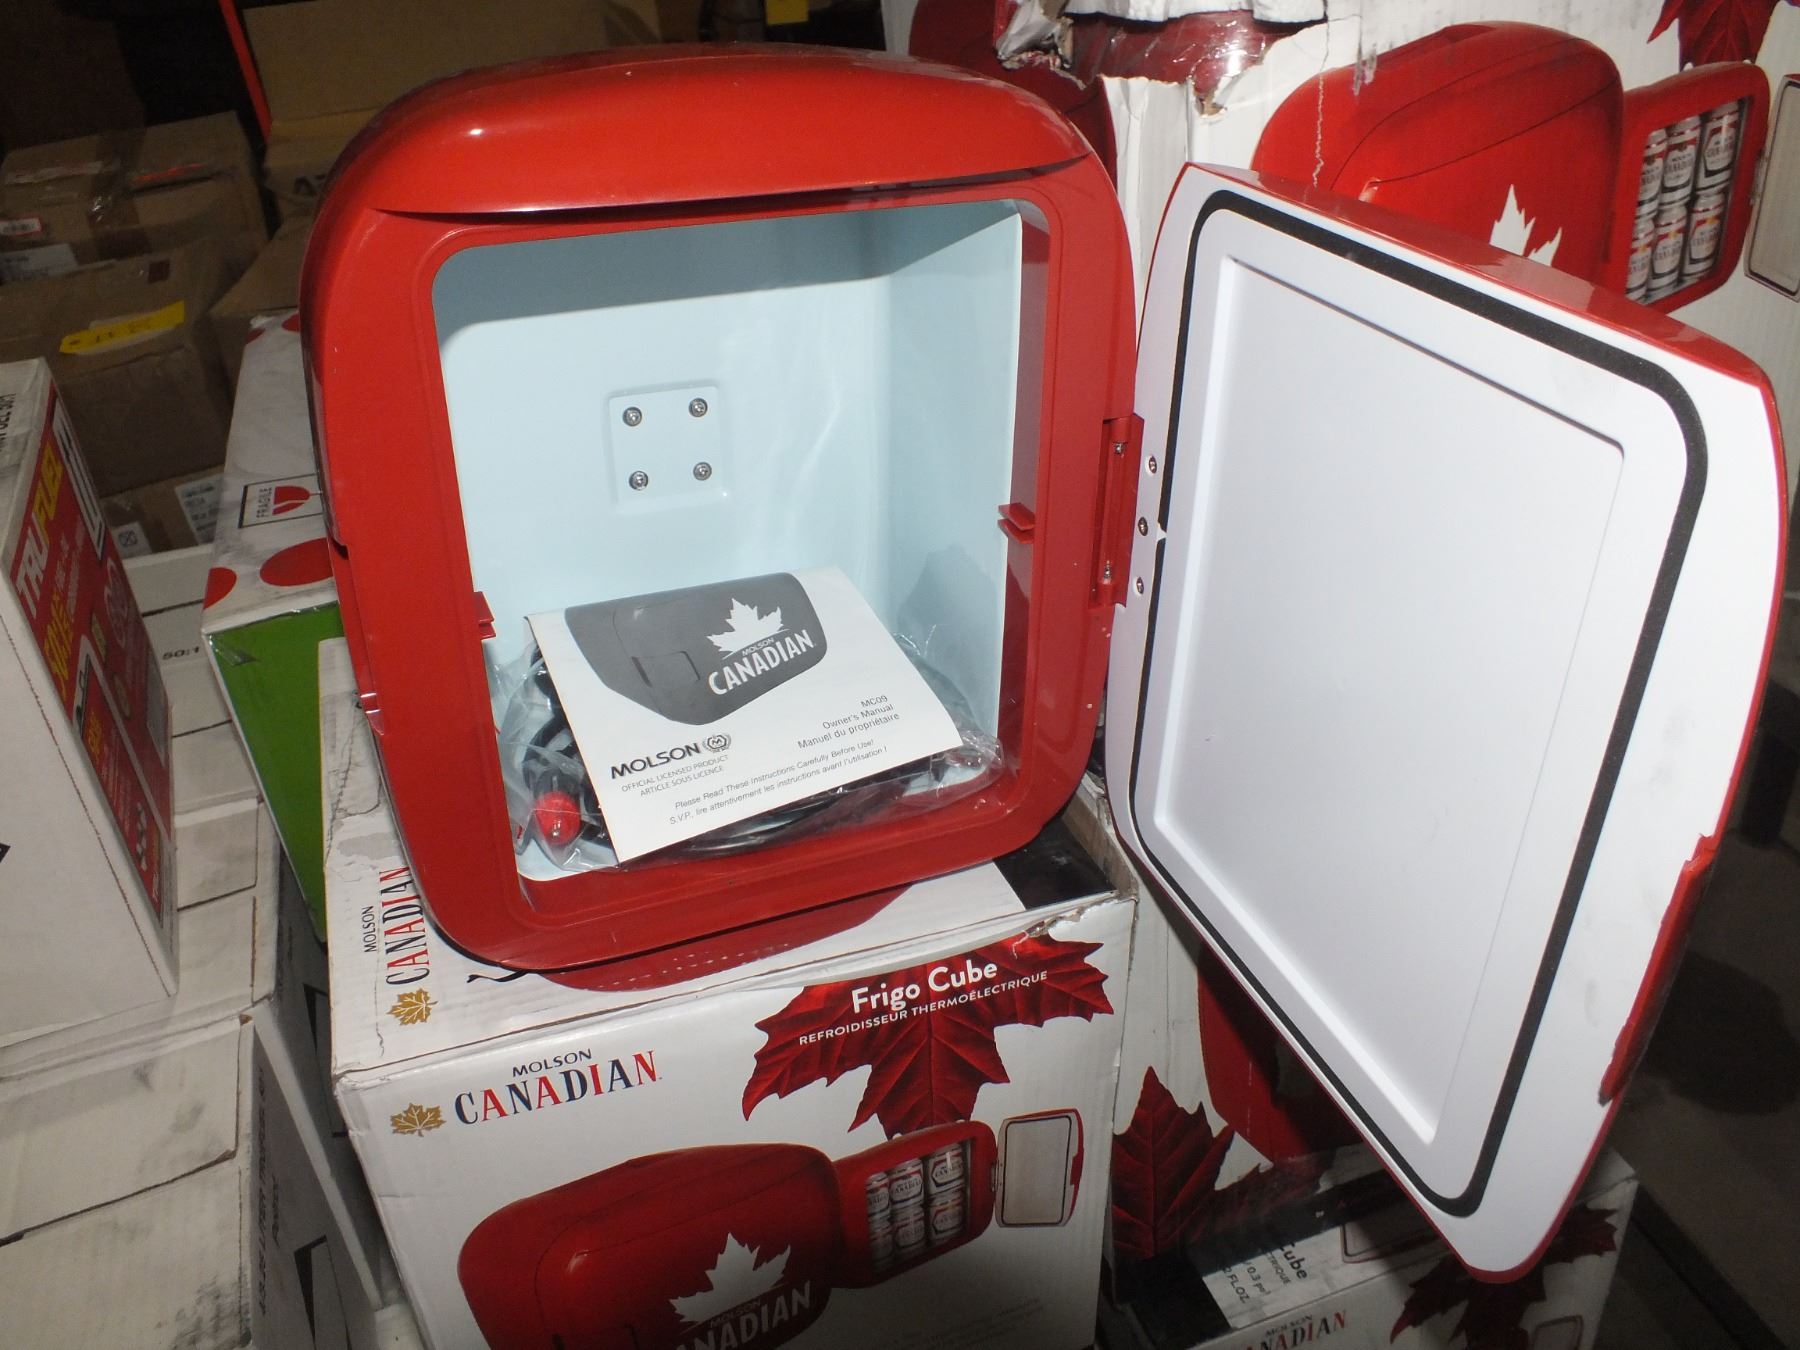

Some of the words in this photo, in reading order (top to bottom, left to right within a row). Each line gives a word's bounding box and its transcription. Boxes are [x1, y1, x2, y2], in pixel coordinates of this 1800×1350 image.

[16, 440, 64, 620] TRUFUEL
[162, 646, 200, 660] 50:1
[708, 629, 814, 695] CANADIAN
[742, 637, 775, 656] MOLSON
[822, 714, 860, 729] Owner's
[860, 703, 894, 718] Manual
[860, 695, 888, 708] MC09
[797, 733, 833, 749] Manuel
[834, 729, 846, 738] du
[848, 713, 900, 734] propriétaire
[611, 743, 701, 779] MOLSON
[621, 778, 656, 793] OFFICIAL
[656, 766, 693, 782] LICENSED
[693, 754, 729, 770] PRODUCT
[640, 782, 671, 797] ARTICLE
[671, 775, 693, 787] SOUS
[694, 765, 723, 780] LICENCE
[675, 796, 701, 809] Please
[703, 789, 724, 799] Read
[726, 780, 749, 792] These
[751, 766, 796, 784] Instructions
[797, 754, 829, 769] Carefully
[831, 746, 856, 758] Before
[710, 788, 762, 811] attentivement
[763, 784, 775, 793] les
[777, 769, 821, 788] instructions
[822, 761, 842, 773] avant
[361, 905, 378, 953] MOLSON
[379, 866, 430, 985] CANADIAN
[799, 1009, 908, 1046] REFROIDISSEUR
[911, 970, 1048, 1016] THERMOÉLECTRIQUE
[852, 982, 921, 1014] Frigo
[928, 959, 998, 993] Cube
[454, 1050, 659, 1125] CANADIAN
[512, 1049, 592, 1078] MOLSON
[676, 1280, 811, 1350] NADIAN
